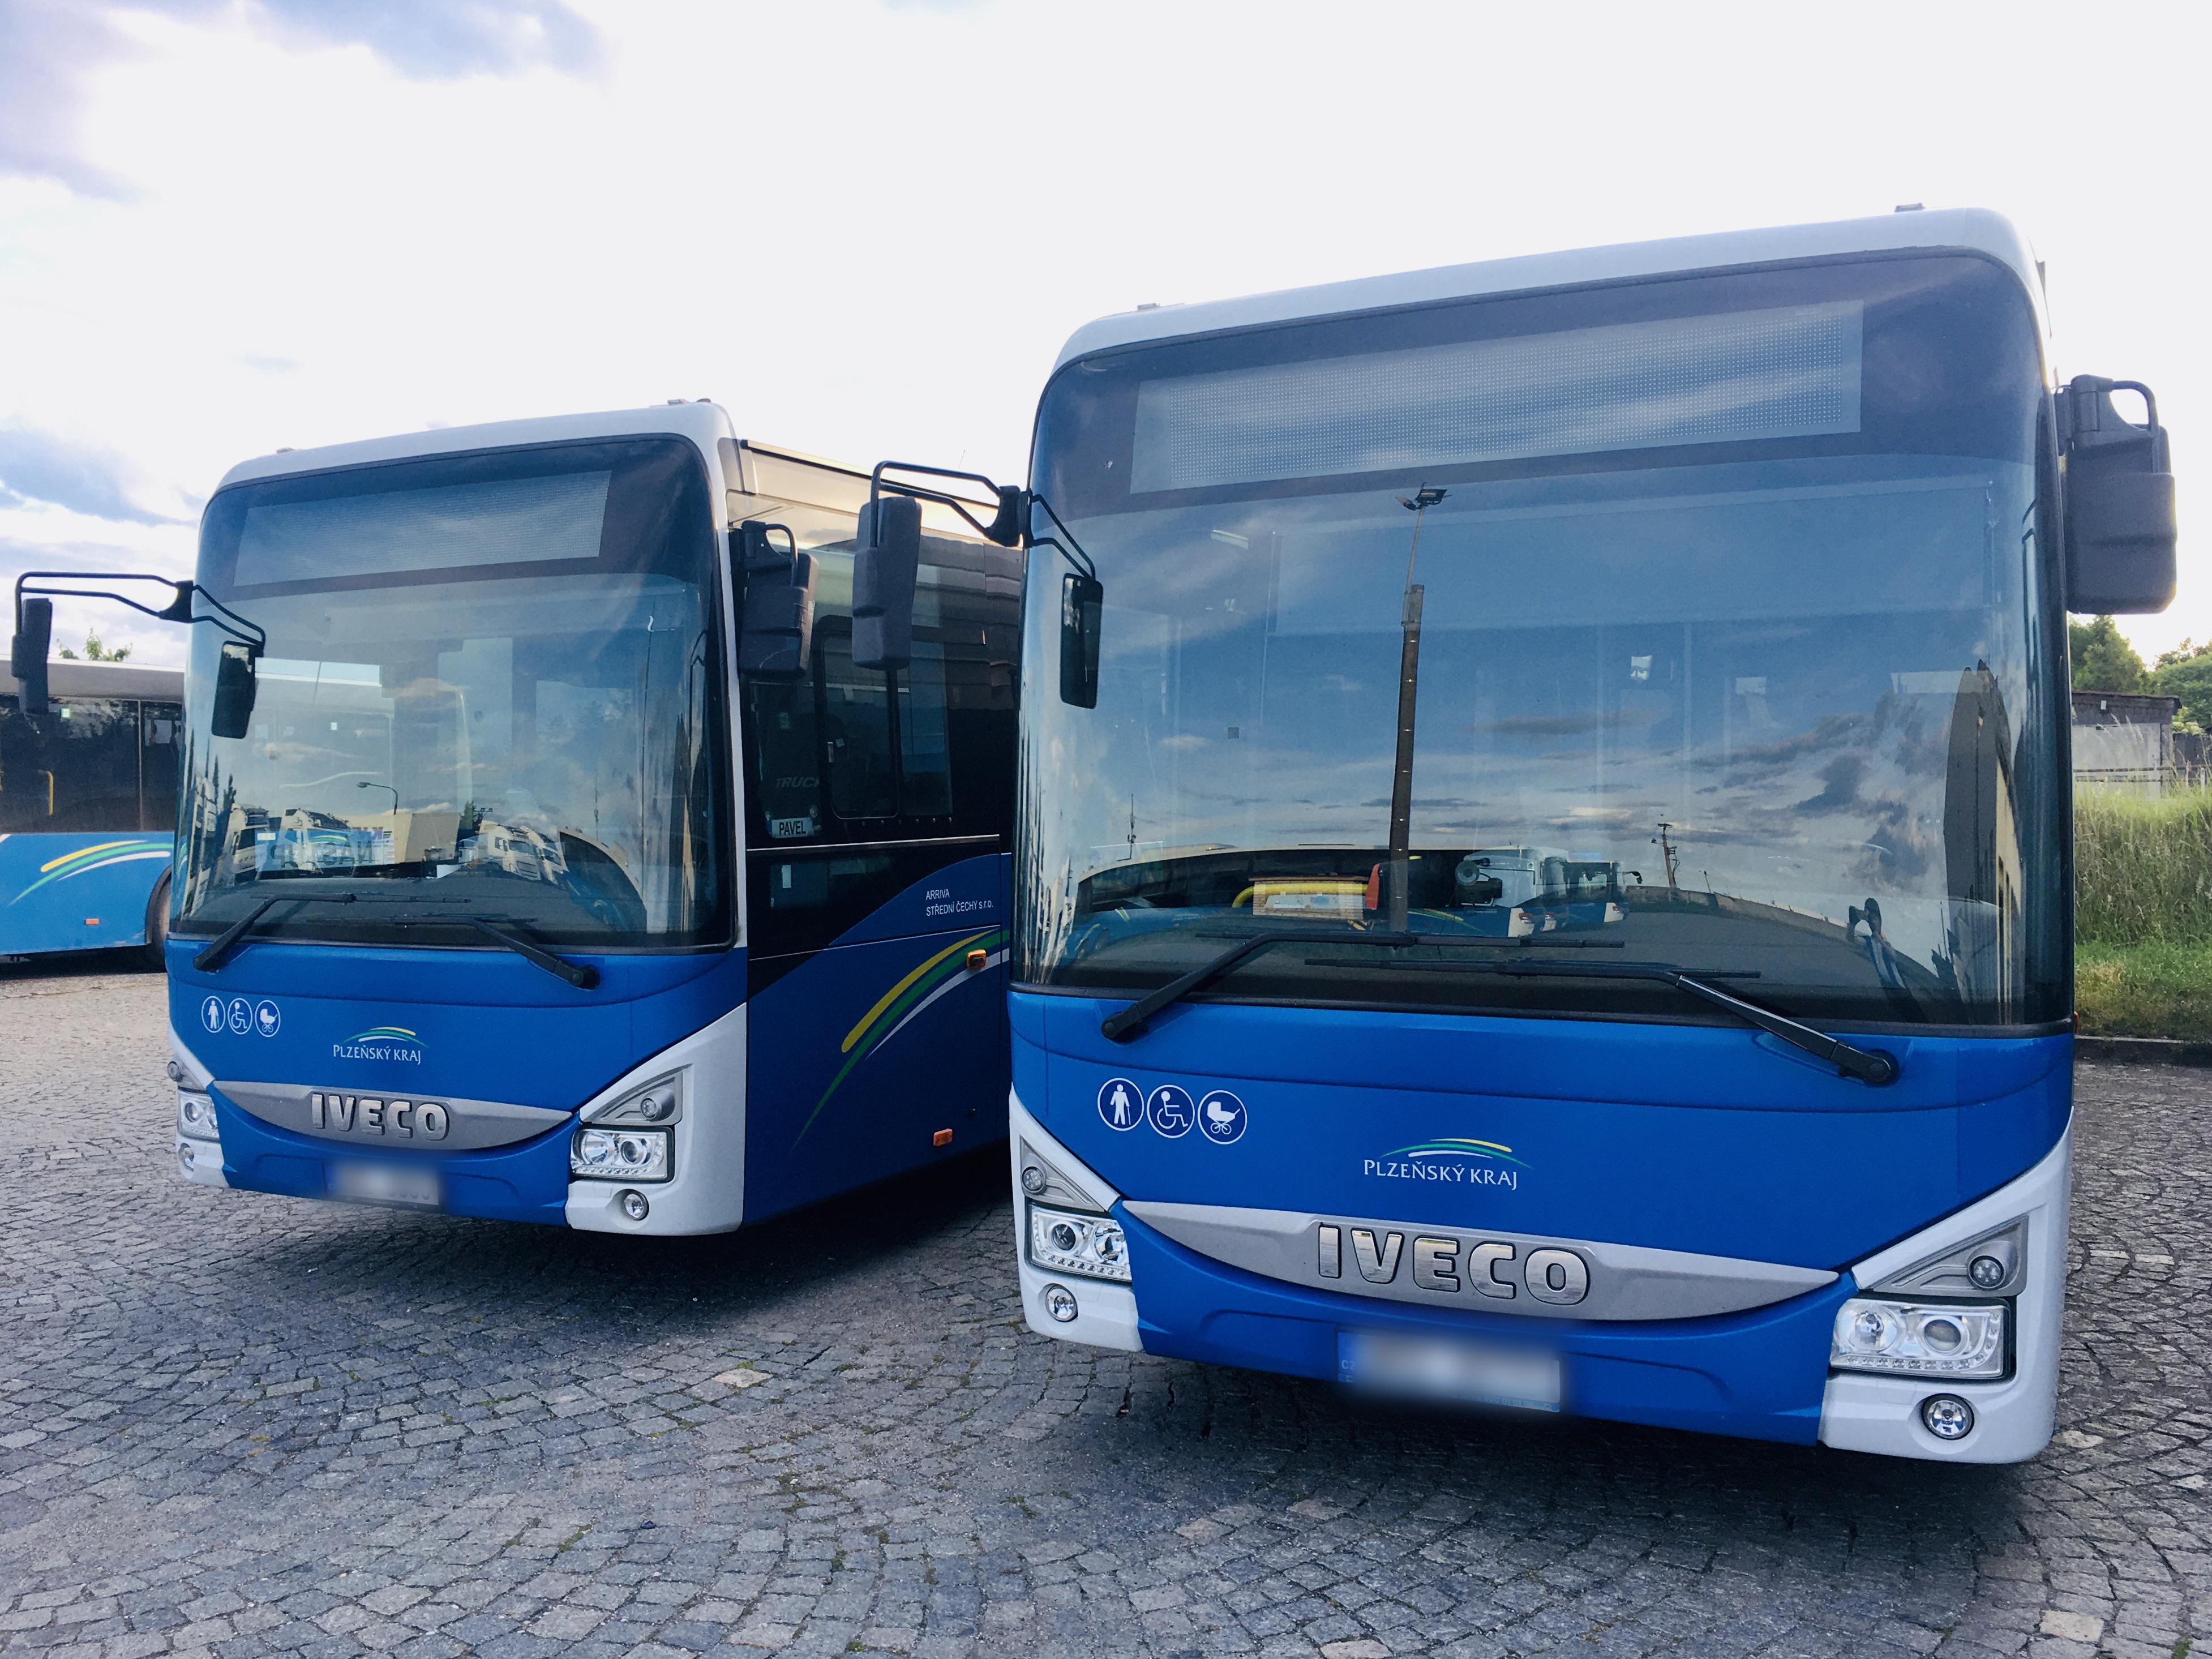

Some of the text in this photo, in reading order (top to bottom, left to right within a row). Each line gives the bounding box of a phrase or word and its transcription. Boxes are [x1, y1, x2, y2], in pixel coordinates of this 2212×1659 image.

[779, 820, 807, 836] PAVEL
[925, 888, 950, 901] ARRIVA
[926, 900, 993, 916] STŘEDNÍ ČECHY s.r.o.
[333, 1044, 421, 1065] PLZEŇSKÝ KRAJ
[312, 1094, 450, 1141] IVECO
[1364, 1159, 1517, 1190] PLZEŇSKÝ KRAJ
[1318, 1225, 1591, 1306] IVECO
